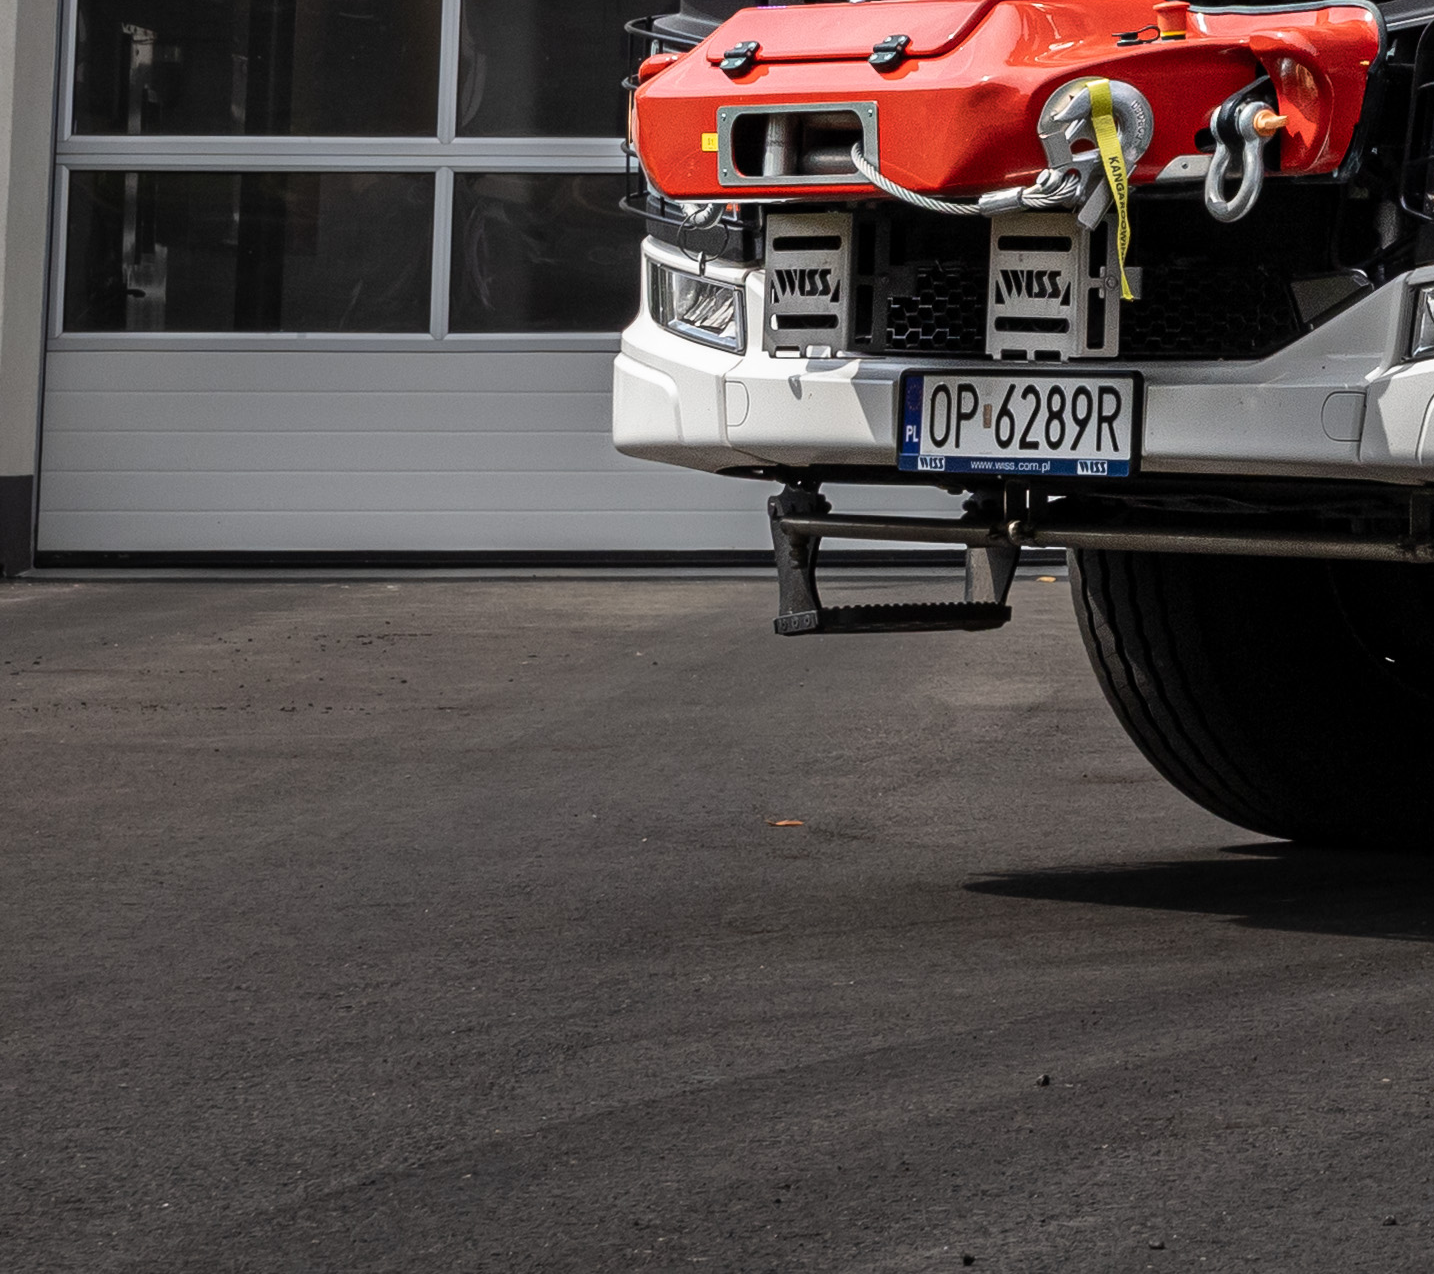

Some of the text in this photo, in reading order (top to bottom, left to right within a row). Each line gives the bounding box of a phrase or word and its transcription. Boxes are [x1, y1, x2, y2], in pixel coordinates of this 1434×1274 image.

[774, 268, 832, 297] WISS
[998, 269, 1062, 299] WISS
[929, 382, 1122, 452] OP 6289R
[905, 424, 919, 443] PL
[919, 457, 1108, 475] WISS www.wiss.com.pl WISS
